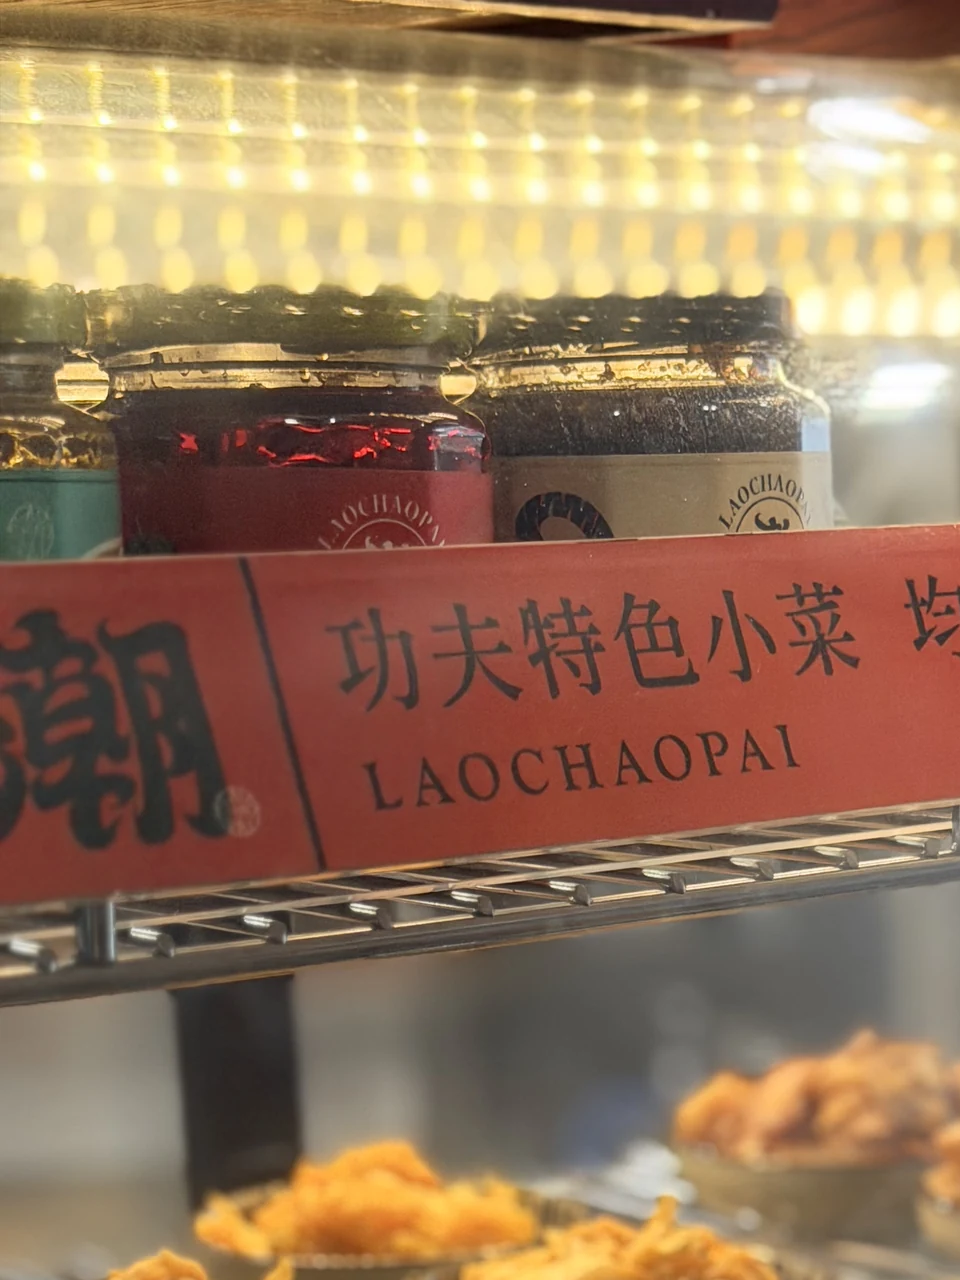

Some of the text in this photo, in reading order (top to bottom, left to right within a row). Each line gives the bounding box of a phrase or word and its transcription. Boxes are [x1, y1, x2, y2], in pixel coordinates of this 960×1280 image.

[326, 582, 861, 712] 功夫特色小菜
[362, 724, 801, 812] LAOCHAOPAI
